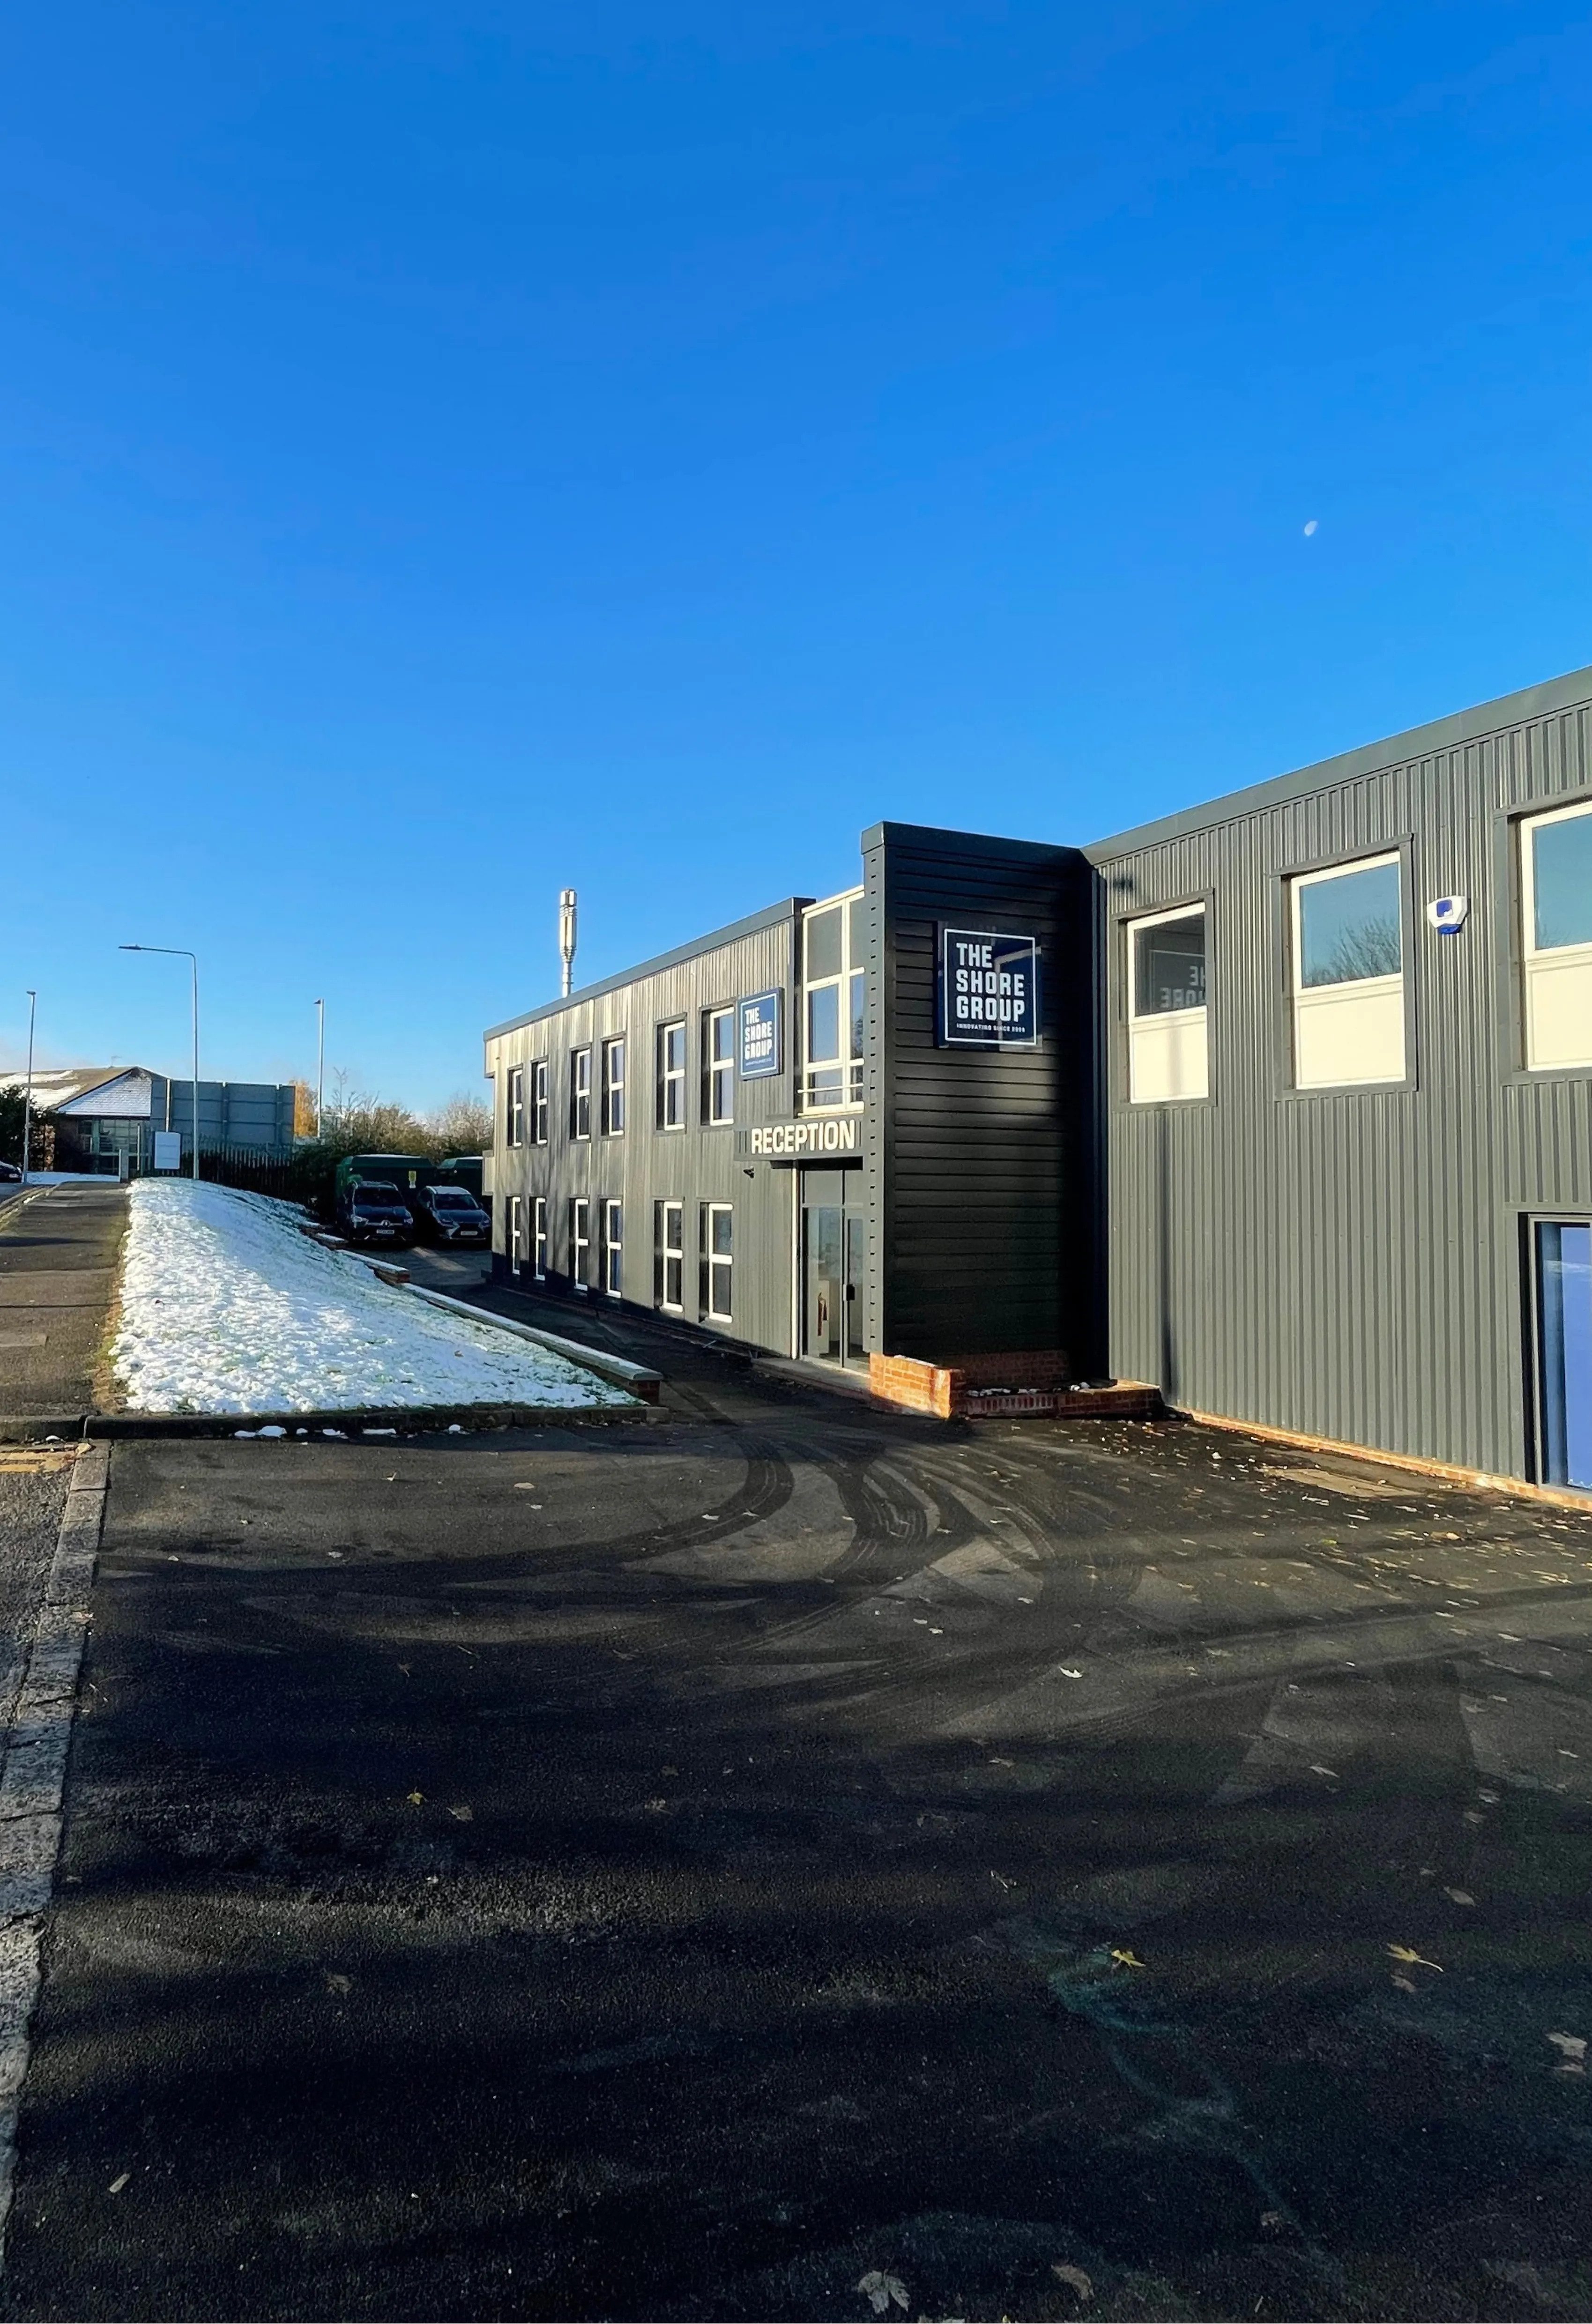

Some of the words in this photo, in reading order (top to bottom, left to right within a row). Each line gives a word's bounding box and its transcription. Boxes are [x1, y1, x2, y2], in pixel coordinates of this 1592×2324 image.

[956, 943, 992, 968] THE
[956, 970, 1025, 996] SHORE
[744, 1007, 760, 1025] THE
[957, 996, 1025, 1022] GROUP
[744, 1021, 773, 1043] SHORE
[744, 1039, 773, 1060] GROUP
[751, 1119, 855, 1154] RECEPTION
